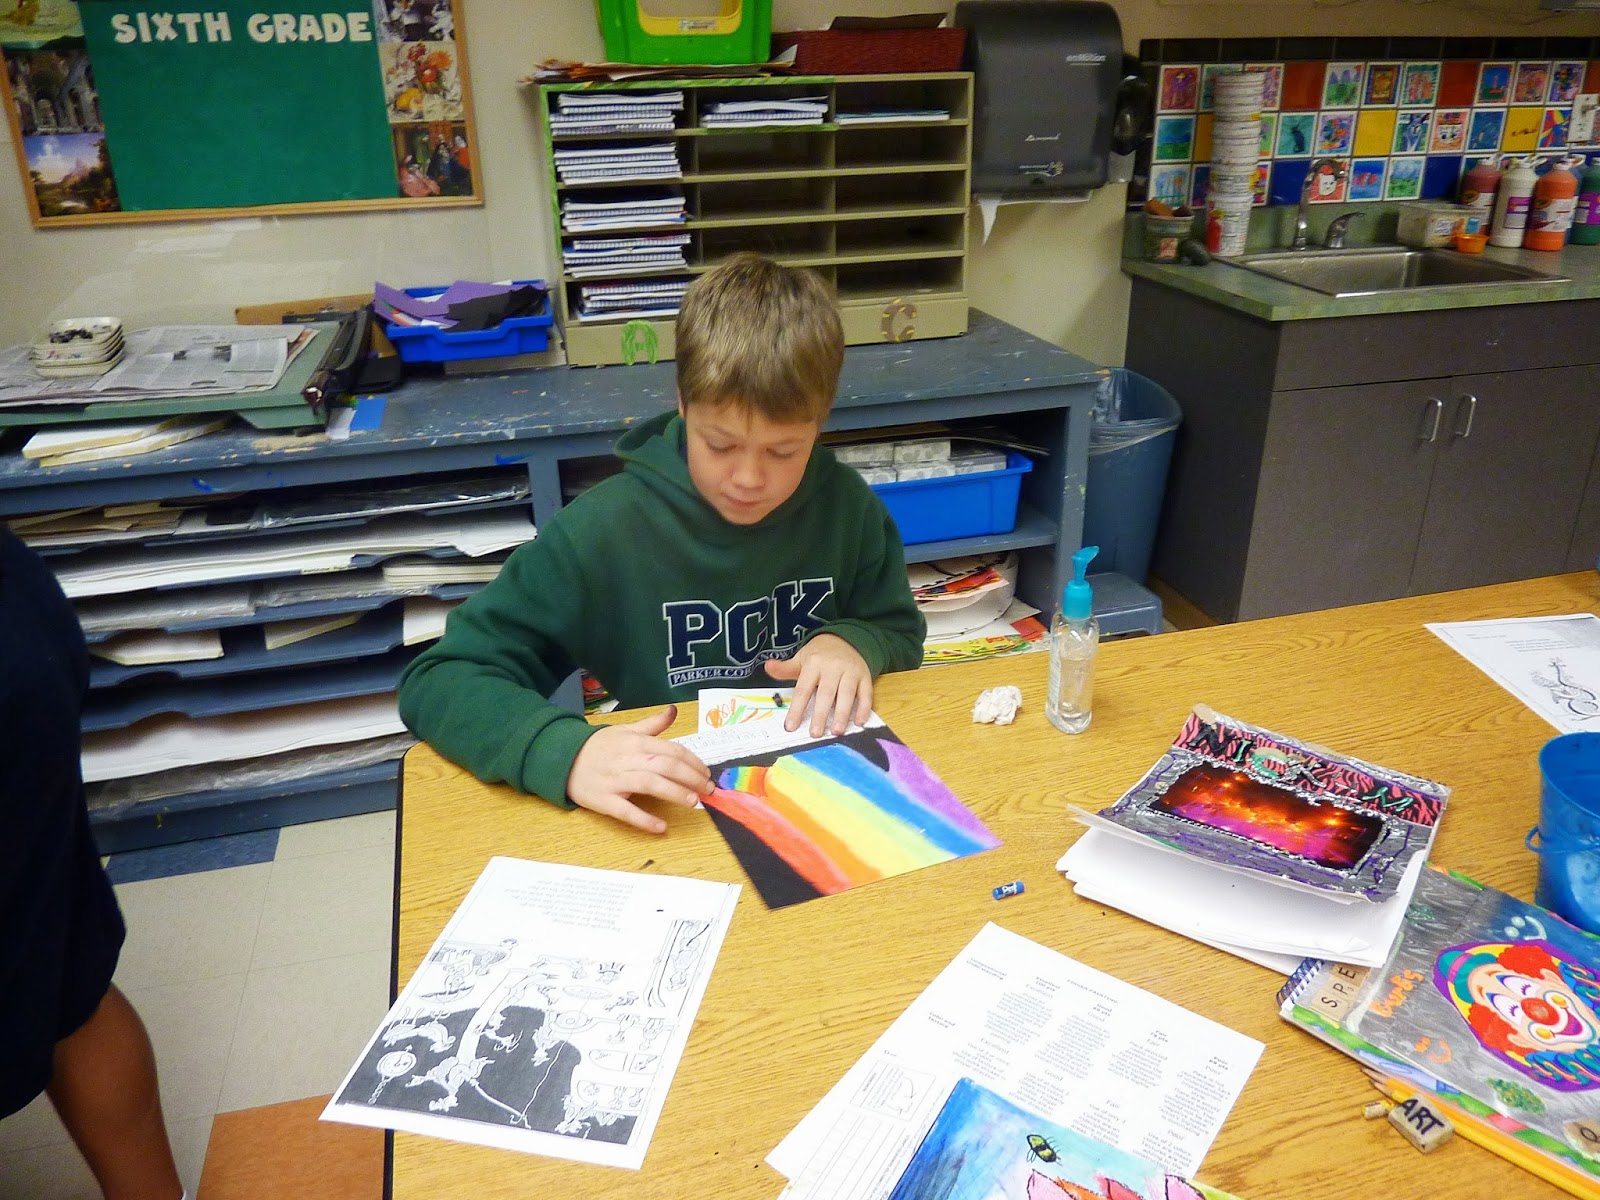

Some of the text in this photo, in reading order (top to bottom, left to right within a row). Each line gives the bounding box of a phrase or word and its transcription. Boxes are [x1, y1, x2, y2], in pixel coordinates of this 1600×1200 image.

[111, 12, 372, 43] SIXTH GRADE
[881, 298, 917, 344] C
[621, 320, 659, 366] A
[662, 577, 835, 671] PCK
[673, 668, 722, 684] PARKER
[724, 667, 755, 677] COR
[1397, 1097, 1445, 1136] ART
